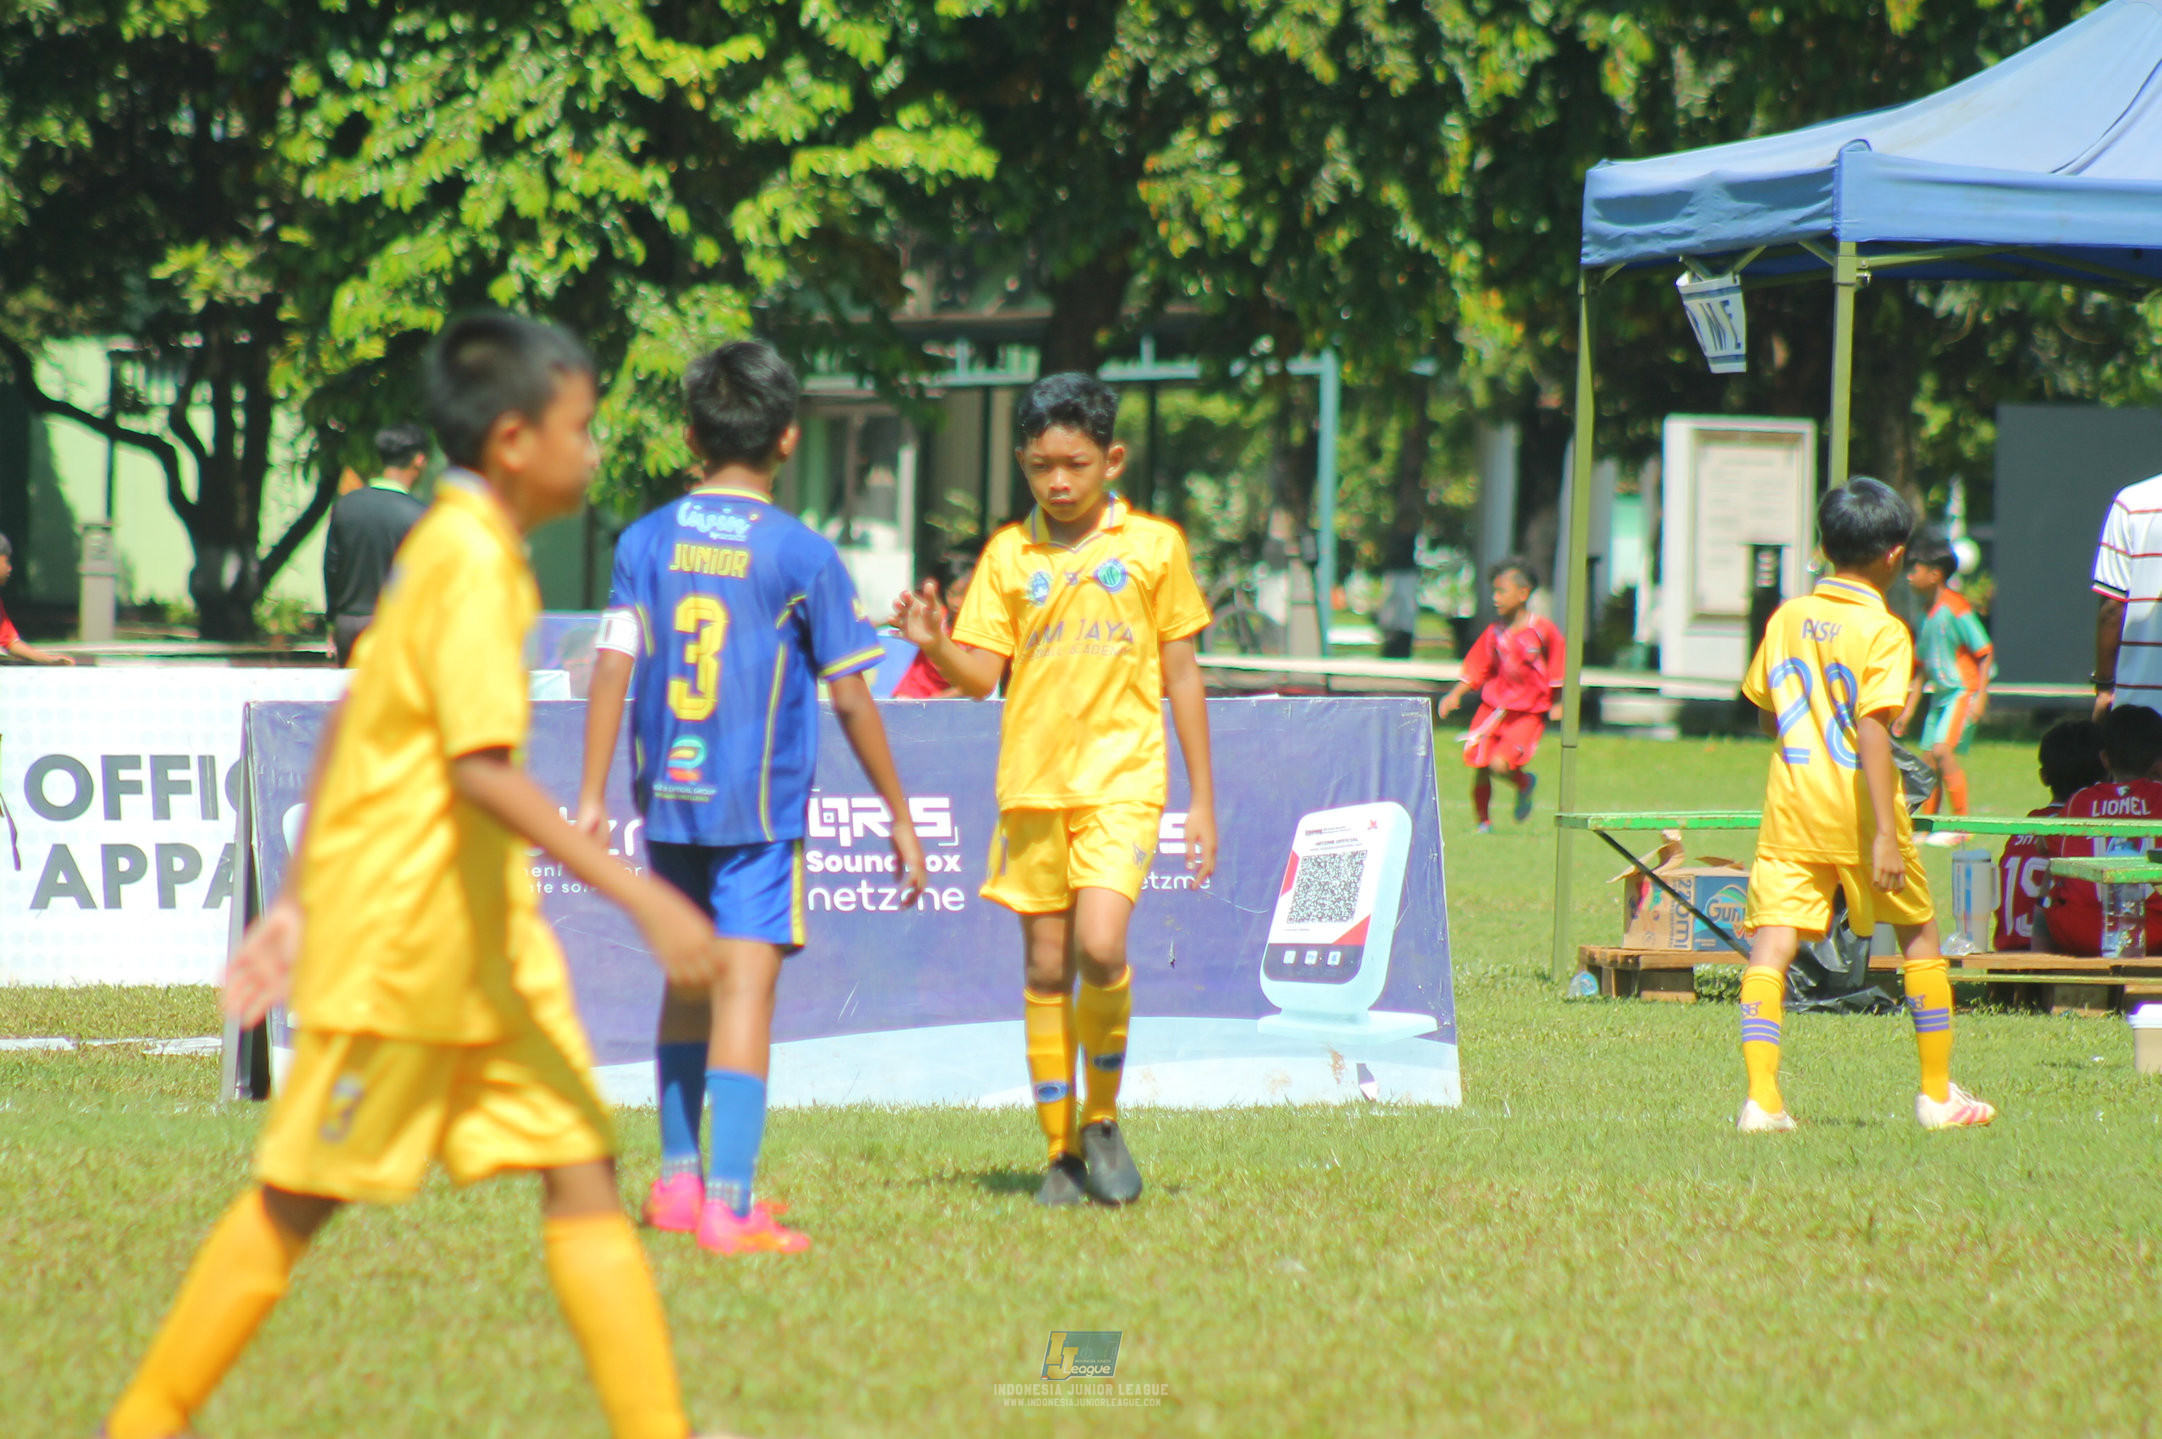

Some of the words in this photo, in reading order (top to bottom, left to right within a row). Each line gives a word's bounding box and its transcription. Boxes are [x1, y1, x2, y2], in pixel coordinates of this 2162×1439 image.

[670, 543, 749, 579] JUNIOR
[667, 593, 730, 721] 3
[24, 754, 242, 822] OFFI
[2091, 796, 2152, 817] LIONEL
[807, 797, 952, 847] QRS
[805, 850, 962, 873] Sounox
